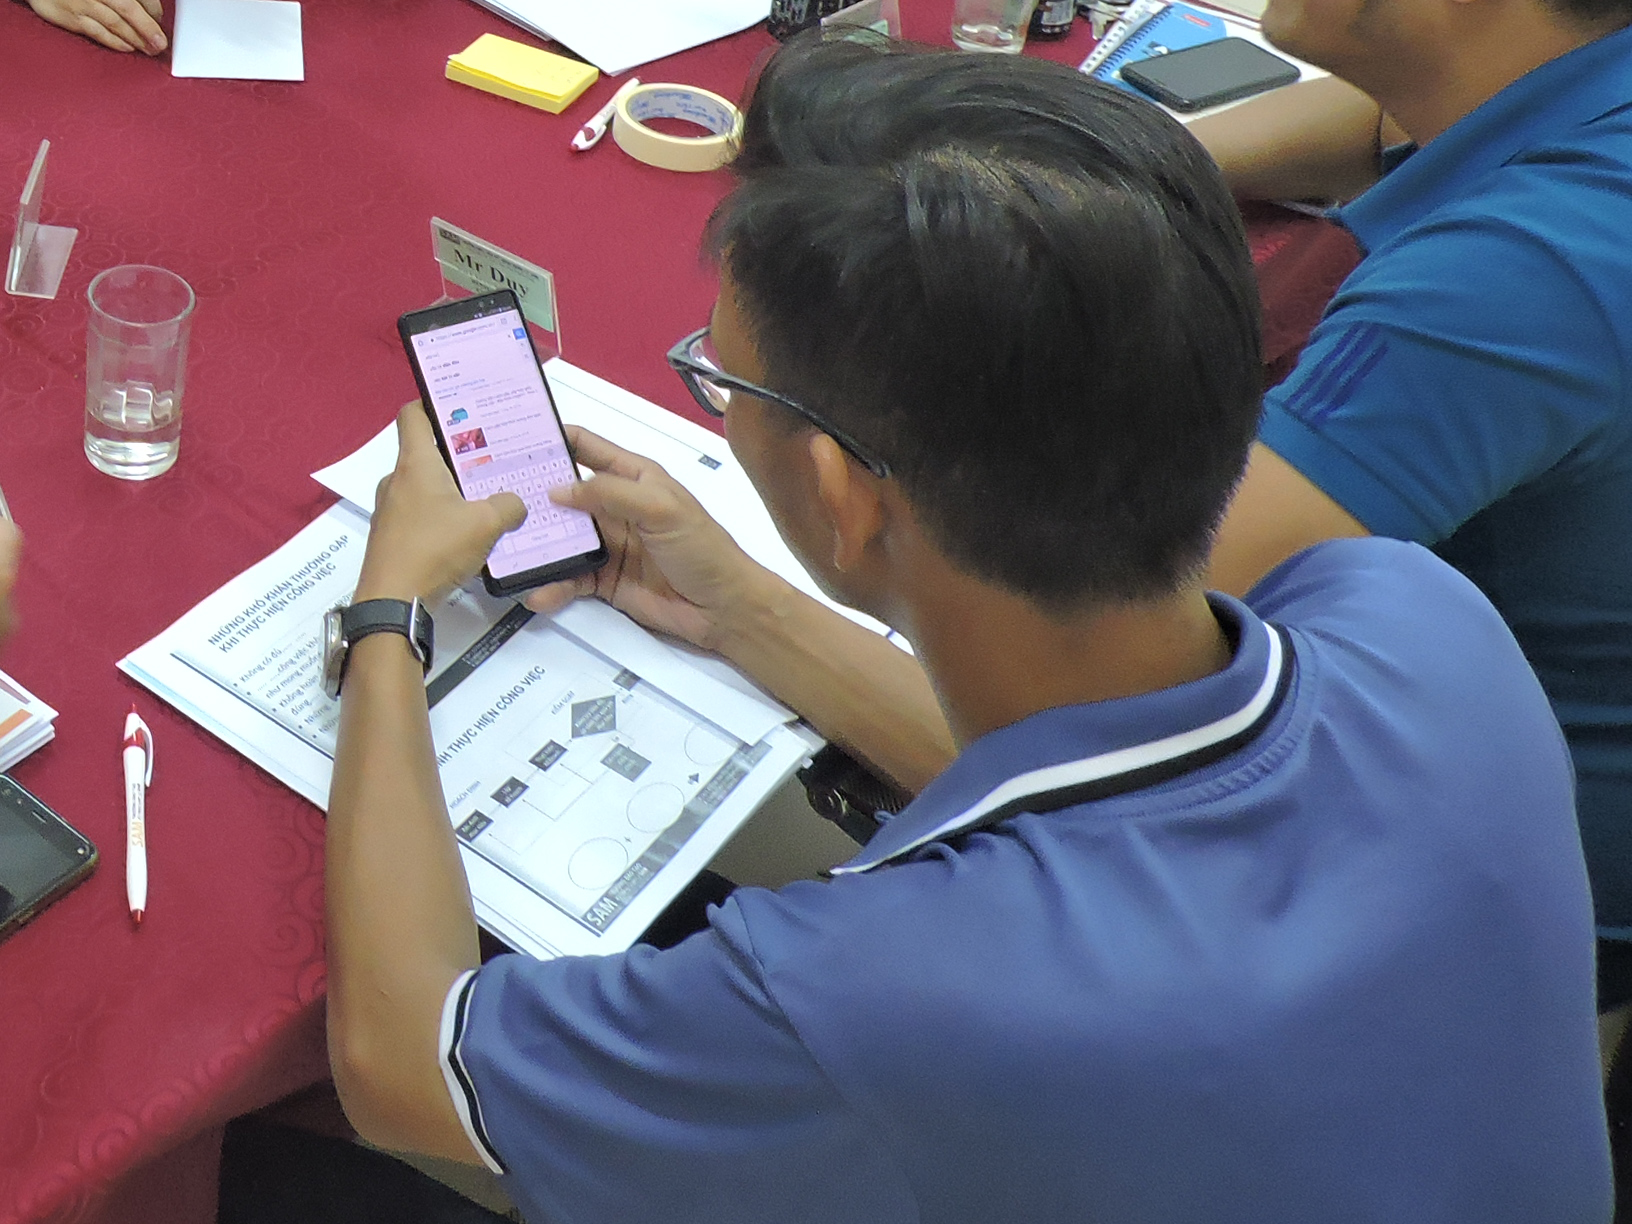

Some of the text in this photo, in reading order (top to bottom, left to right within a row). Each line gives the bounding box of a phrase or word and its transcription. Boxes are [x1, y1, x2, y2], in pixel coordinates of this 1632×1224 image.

[454, 249, 483, 272] Mr
[490, 266, 528, 298] Duy
[218, 634, 239, 654] KHI
[286, 578, 315, 603] CÔNG
[448, 727, 478, 755] THỰC
[474, 707, 501, 732] HIỆN
[494, 683, 525, 711] CÔNG
[521, 665, 546, 688] VIỆC
[585, 895, 618, 927] SAM
